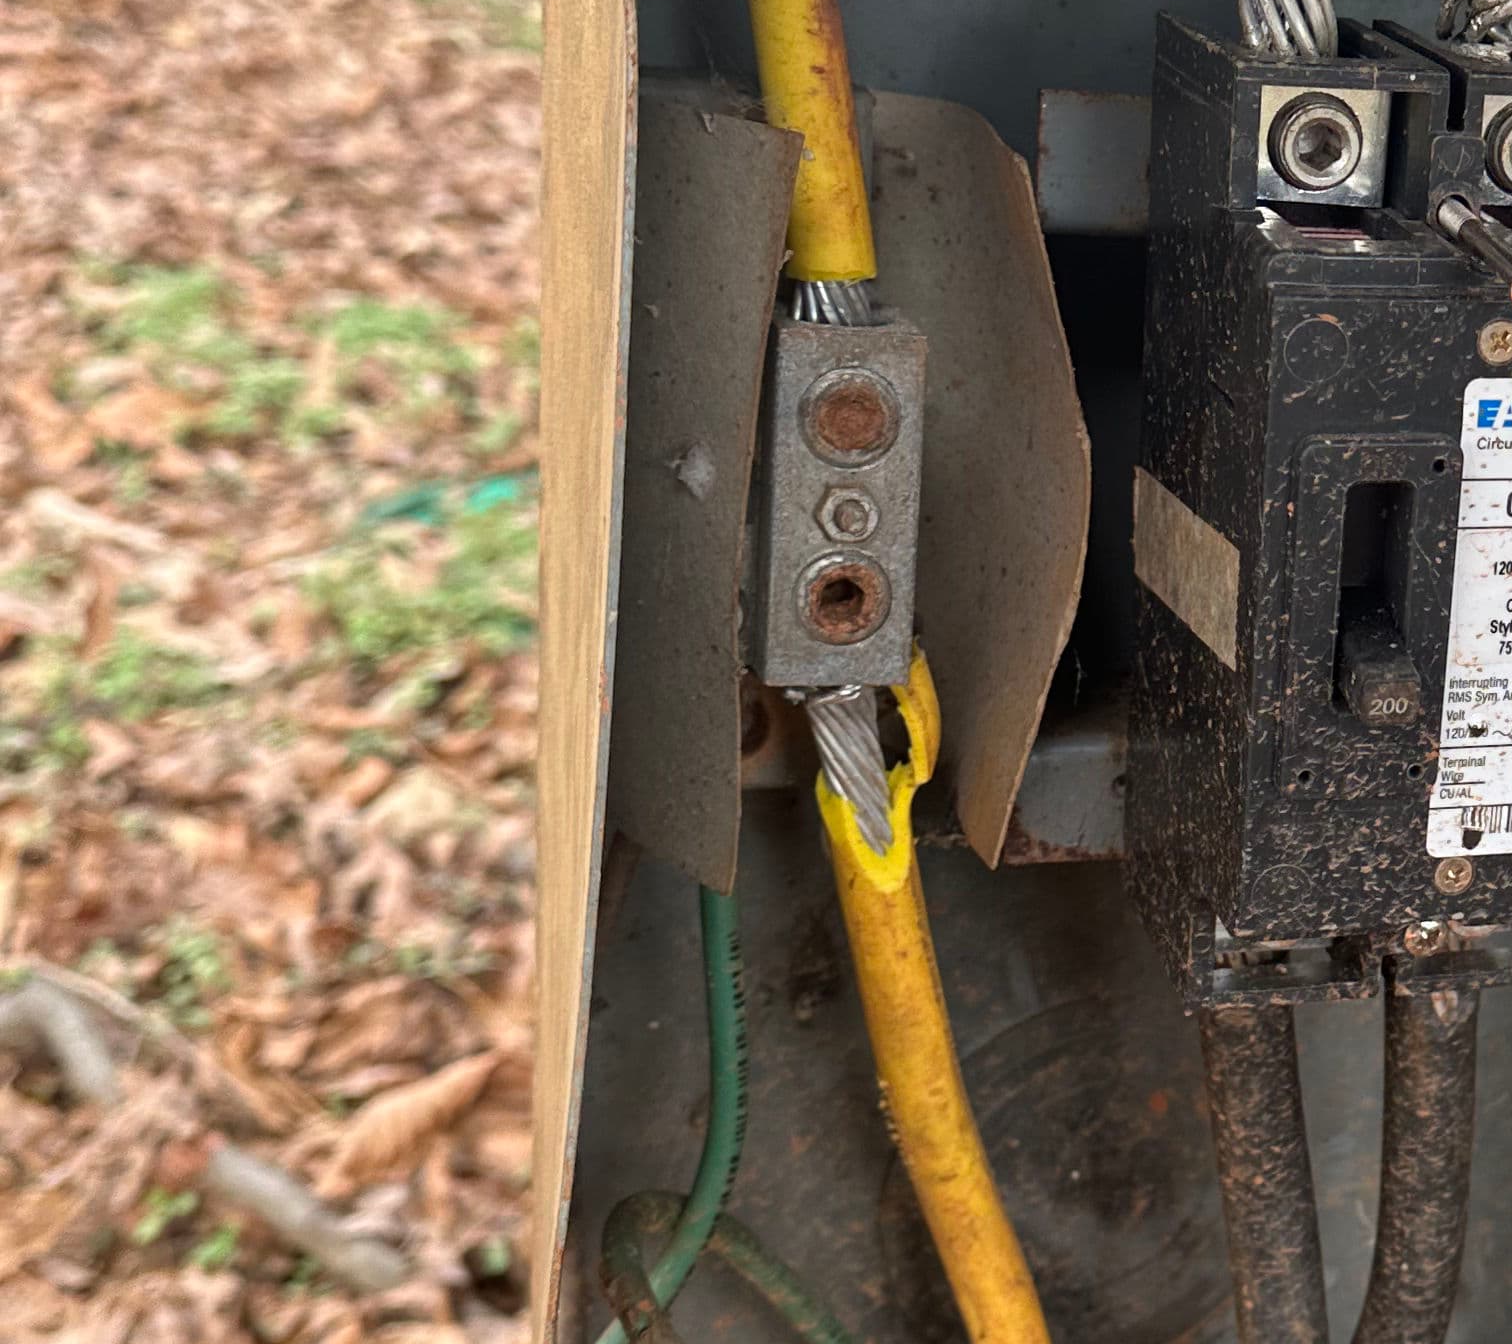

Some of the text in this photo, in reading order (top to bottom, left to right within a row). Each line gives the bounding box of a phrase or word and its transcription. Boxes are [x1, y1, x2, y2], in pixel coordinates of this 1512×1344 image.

[1449, 677, 1509, 690] Interrupting
[1448, 691, 1472, 703] RMS
[1369, 697, 1409, 716] 200
[1446, 710, 1465, 721] Volt
[1443, 755, 1486, 769] Terminal
